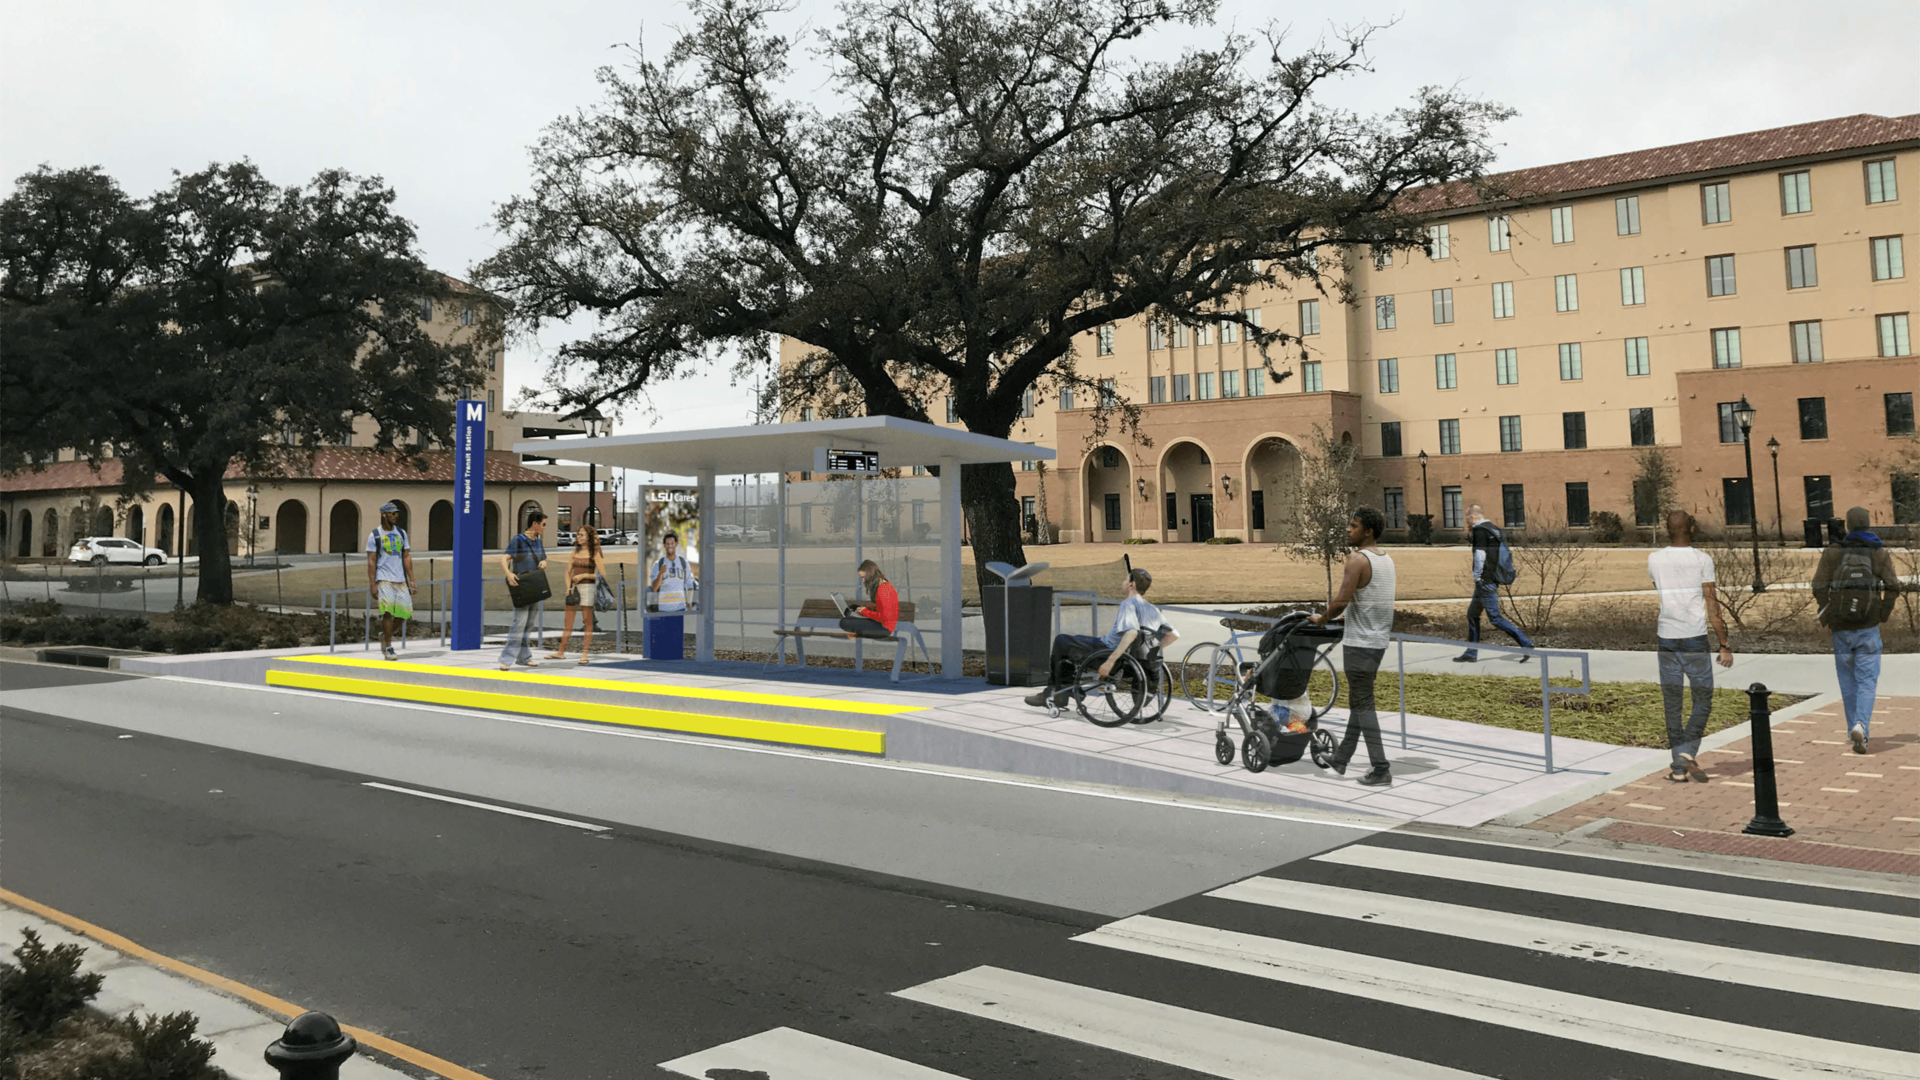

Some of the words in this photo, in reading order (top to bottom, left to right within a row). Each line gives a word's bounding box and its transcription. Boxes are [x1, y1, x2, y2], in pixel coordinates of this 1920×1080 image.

[467, 402, 482, 421] M
[464, 453, 472, 477] Transit
[464, 479, 472, 498] Rapid
[651, 492, 673, 502] LSU
[674, 492, 695, 502] Cares
